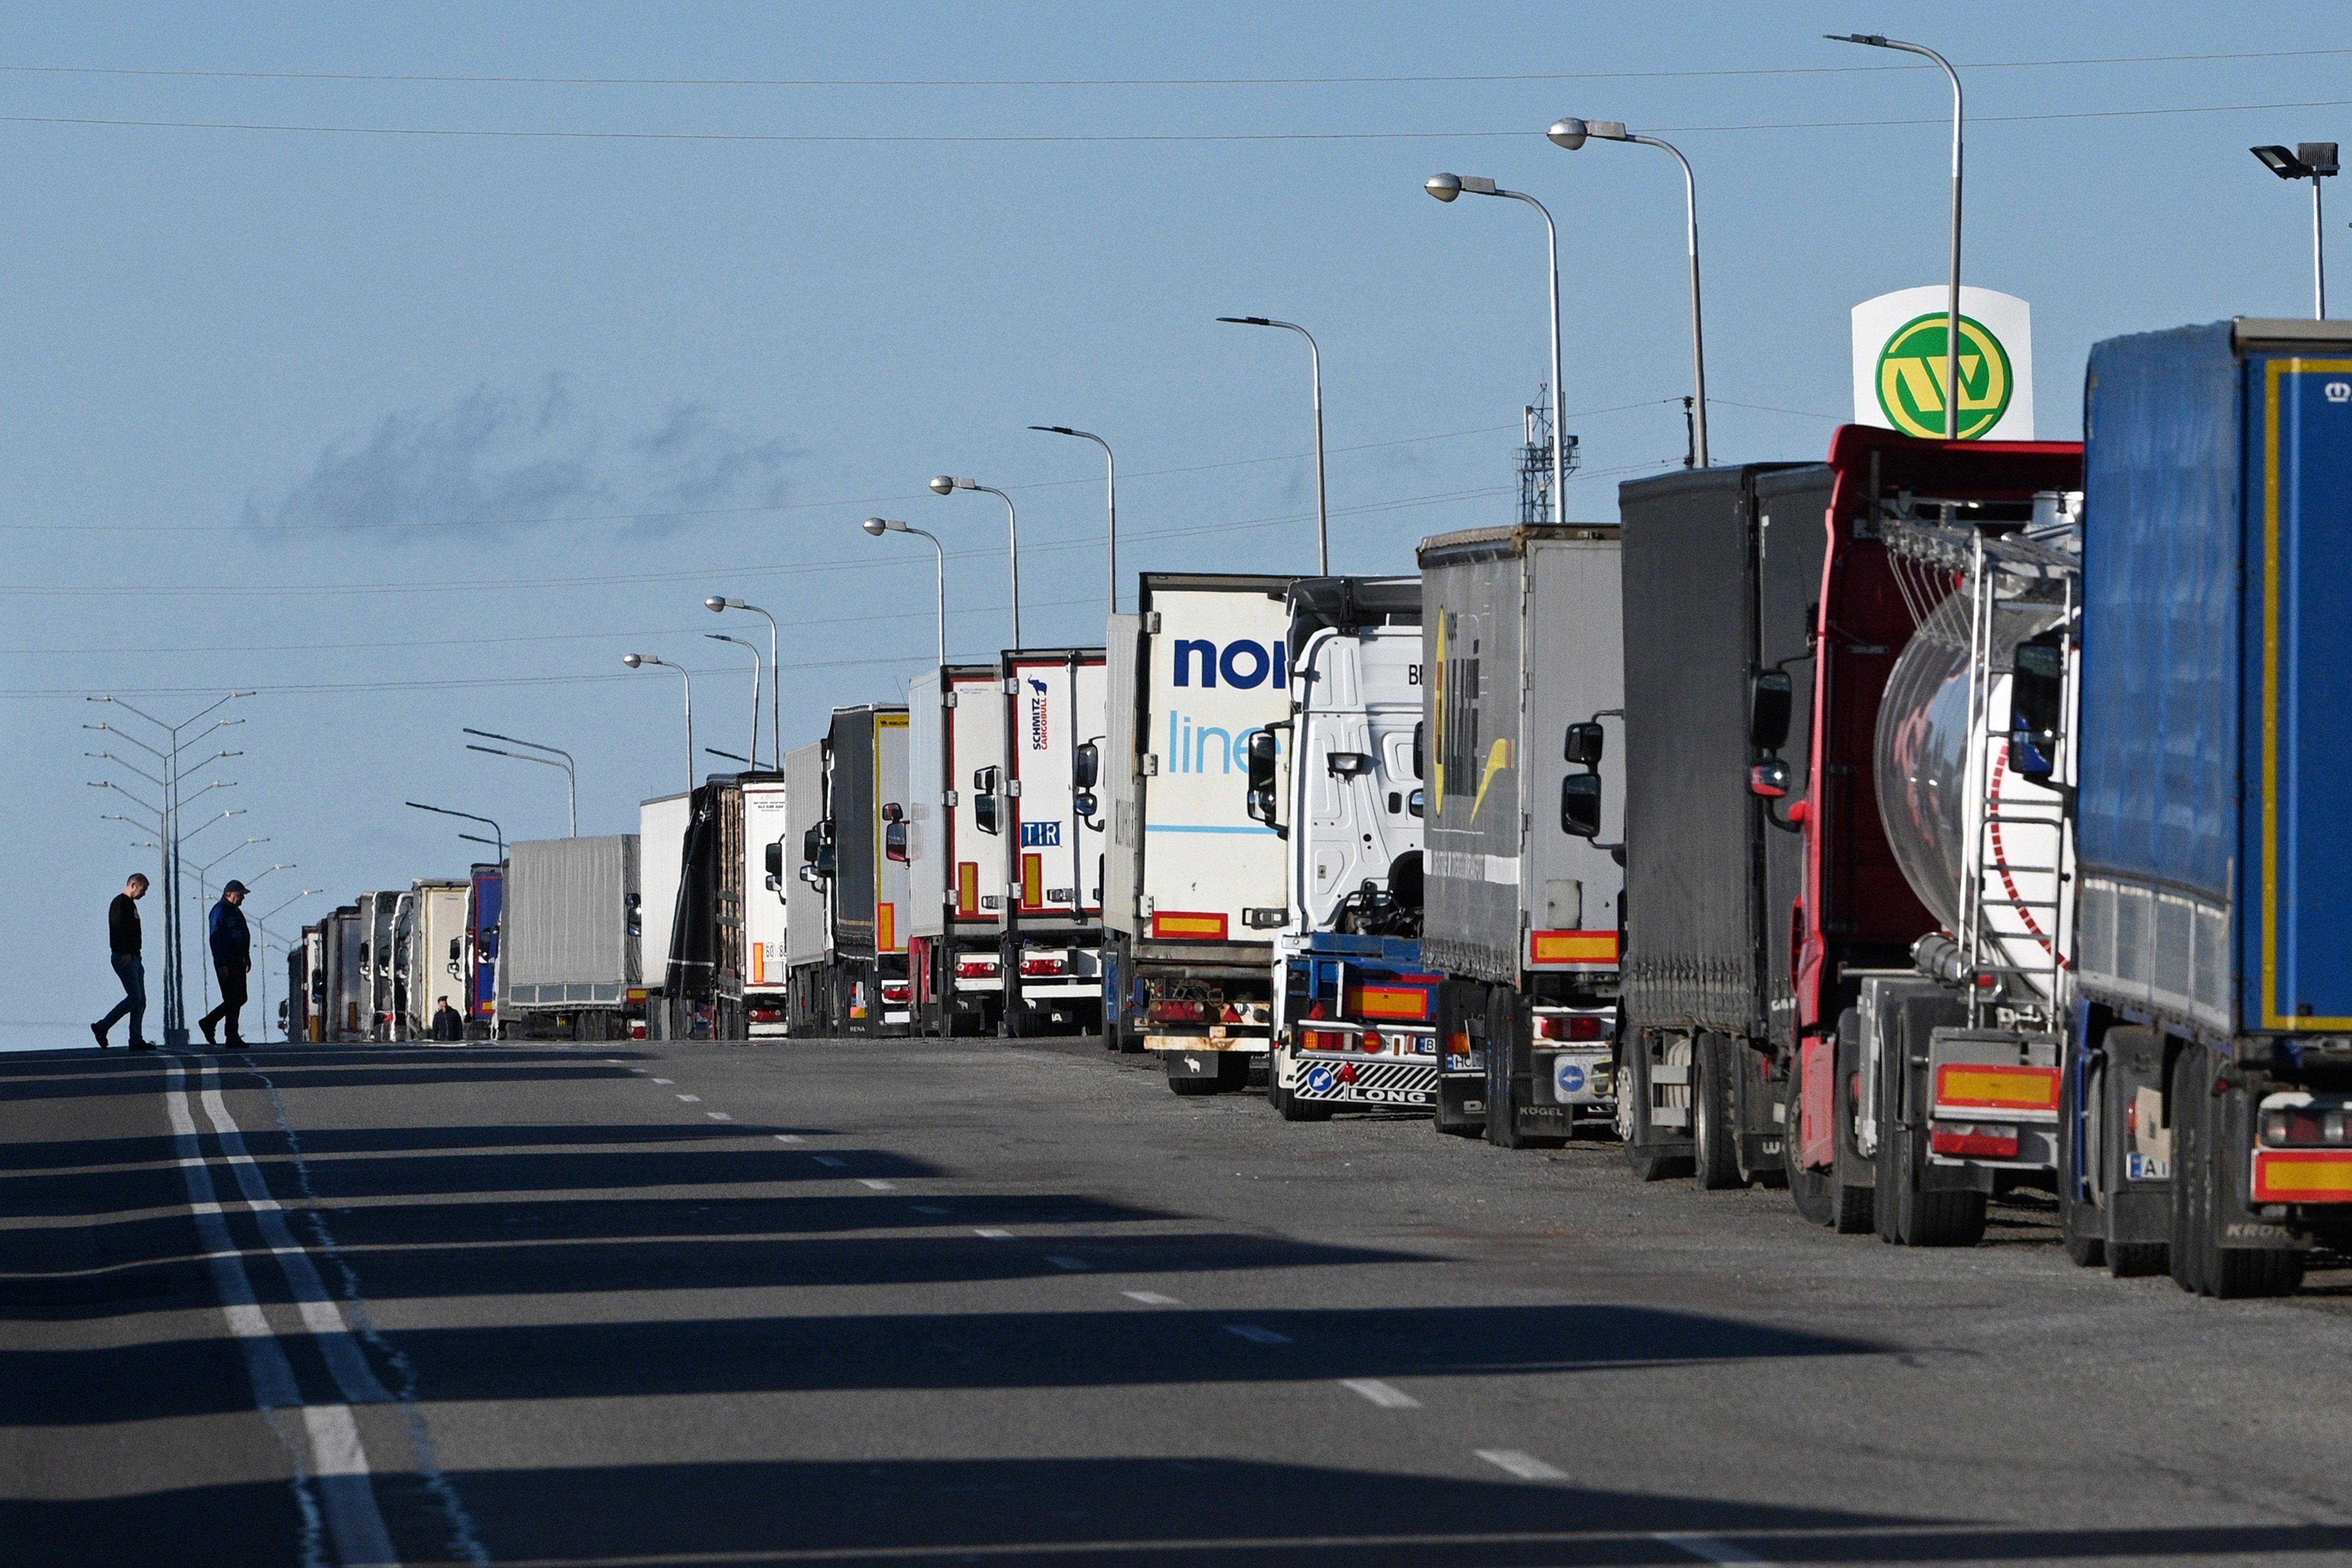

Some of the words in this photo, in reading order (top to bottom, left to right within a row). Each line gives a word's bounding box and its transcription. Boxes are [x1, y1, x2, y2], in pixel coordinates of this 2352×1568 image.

[1032, 698, 1040, 750] SCHMITZ
[1024, 824, 1057, 844] TIR
[766, 945, 774, 957] 60
[1350, 1089, 1426, 1103] LONG
